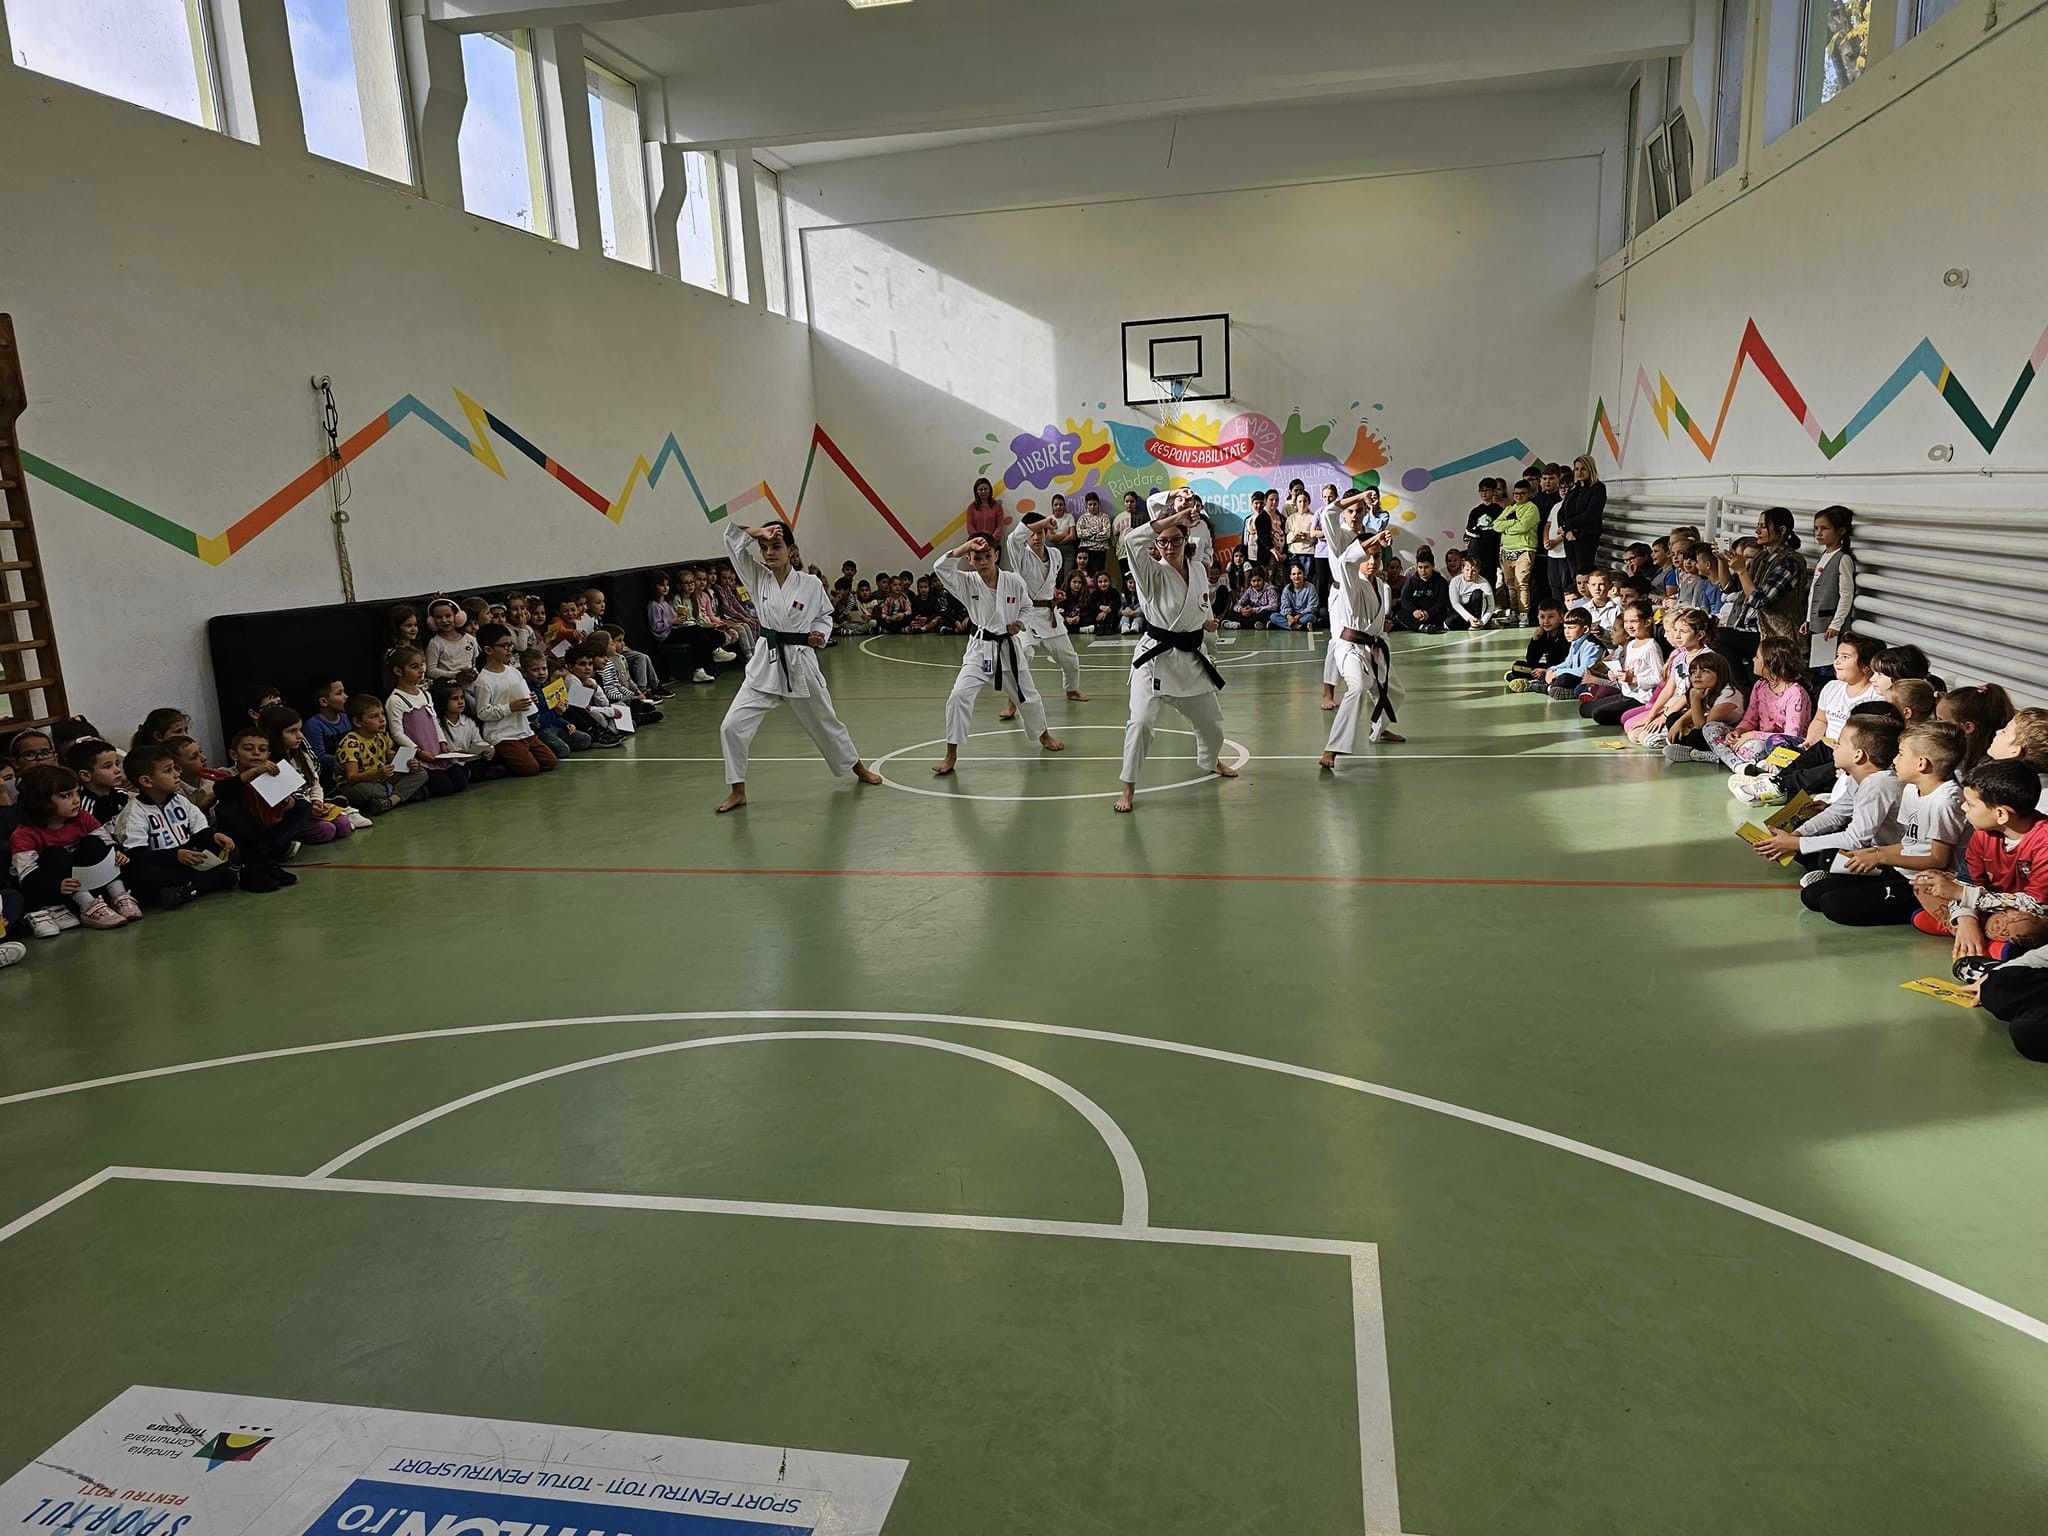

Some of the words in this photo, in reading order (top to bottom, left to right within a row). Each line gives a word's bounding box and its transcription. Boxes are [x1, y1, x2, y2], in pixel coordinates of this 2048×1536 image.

[1016, 441, 1071, 477] IUBIRE
[1150, 441, 1248, 464] RESPONSABILITATE
[1107, 469, 1164, 499] Răbdare
[537, 1471, 594, 1492] TOTUL
[120, 1490, 189, 1506] PENTRU
[649, 1484, 733, 1507] PENTRU
[731, 1492, 802, 1514] SPORT
